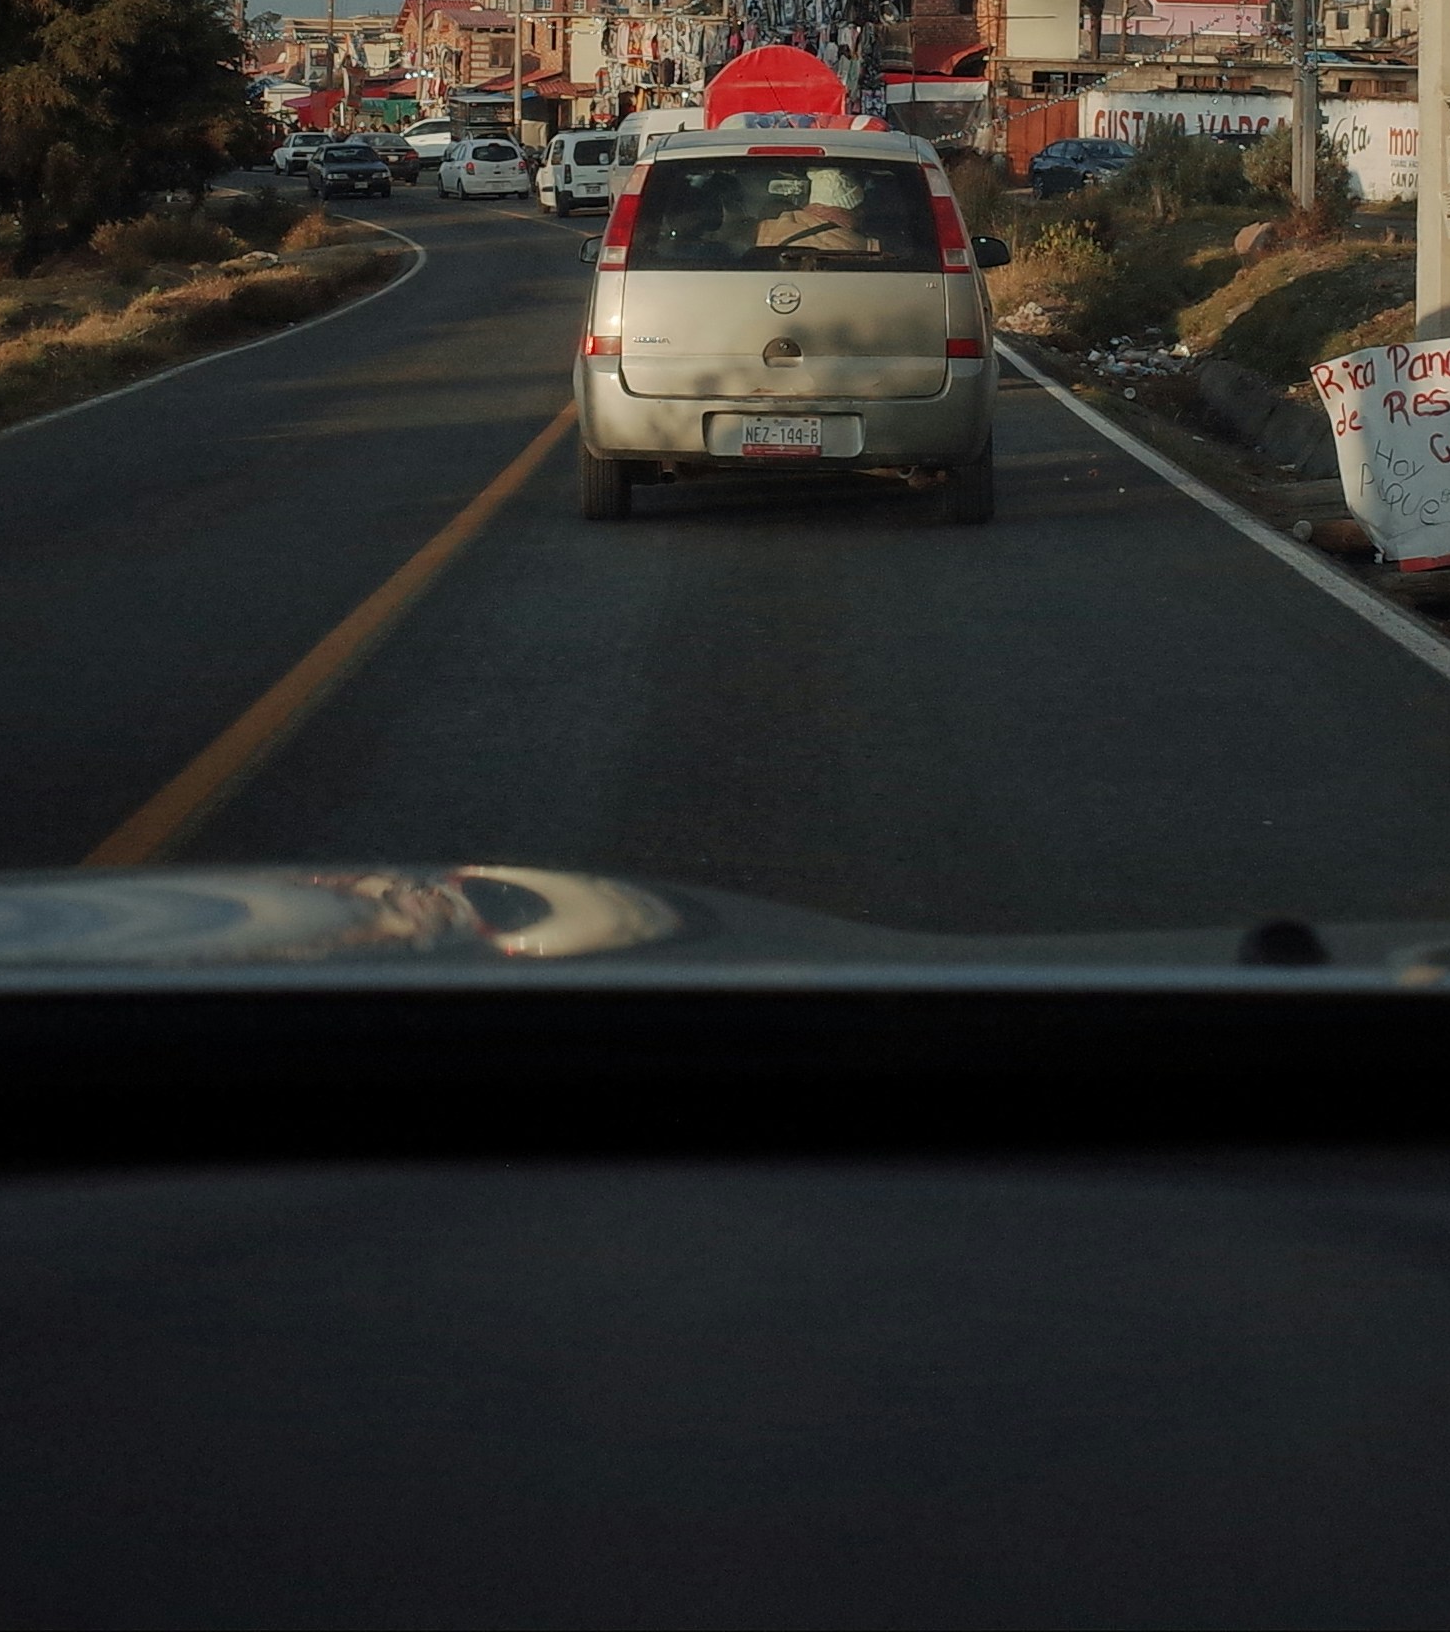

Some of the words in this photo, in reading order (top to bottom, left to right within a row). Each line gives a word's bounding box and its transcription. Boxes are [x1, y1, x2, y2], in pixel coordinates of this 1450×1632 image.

[1312, 358, 1376, 400] Rica
[745, 426, 819, 444] NEZ-144-B
[1335, 402, 1364, 437] de
